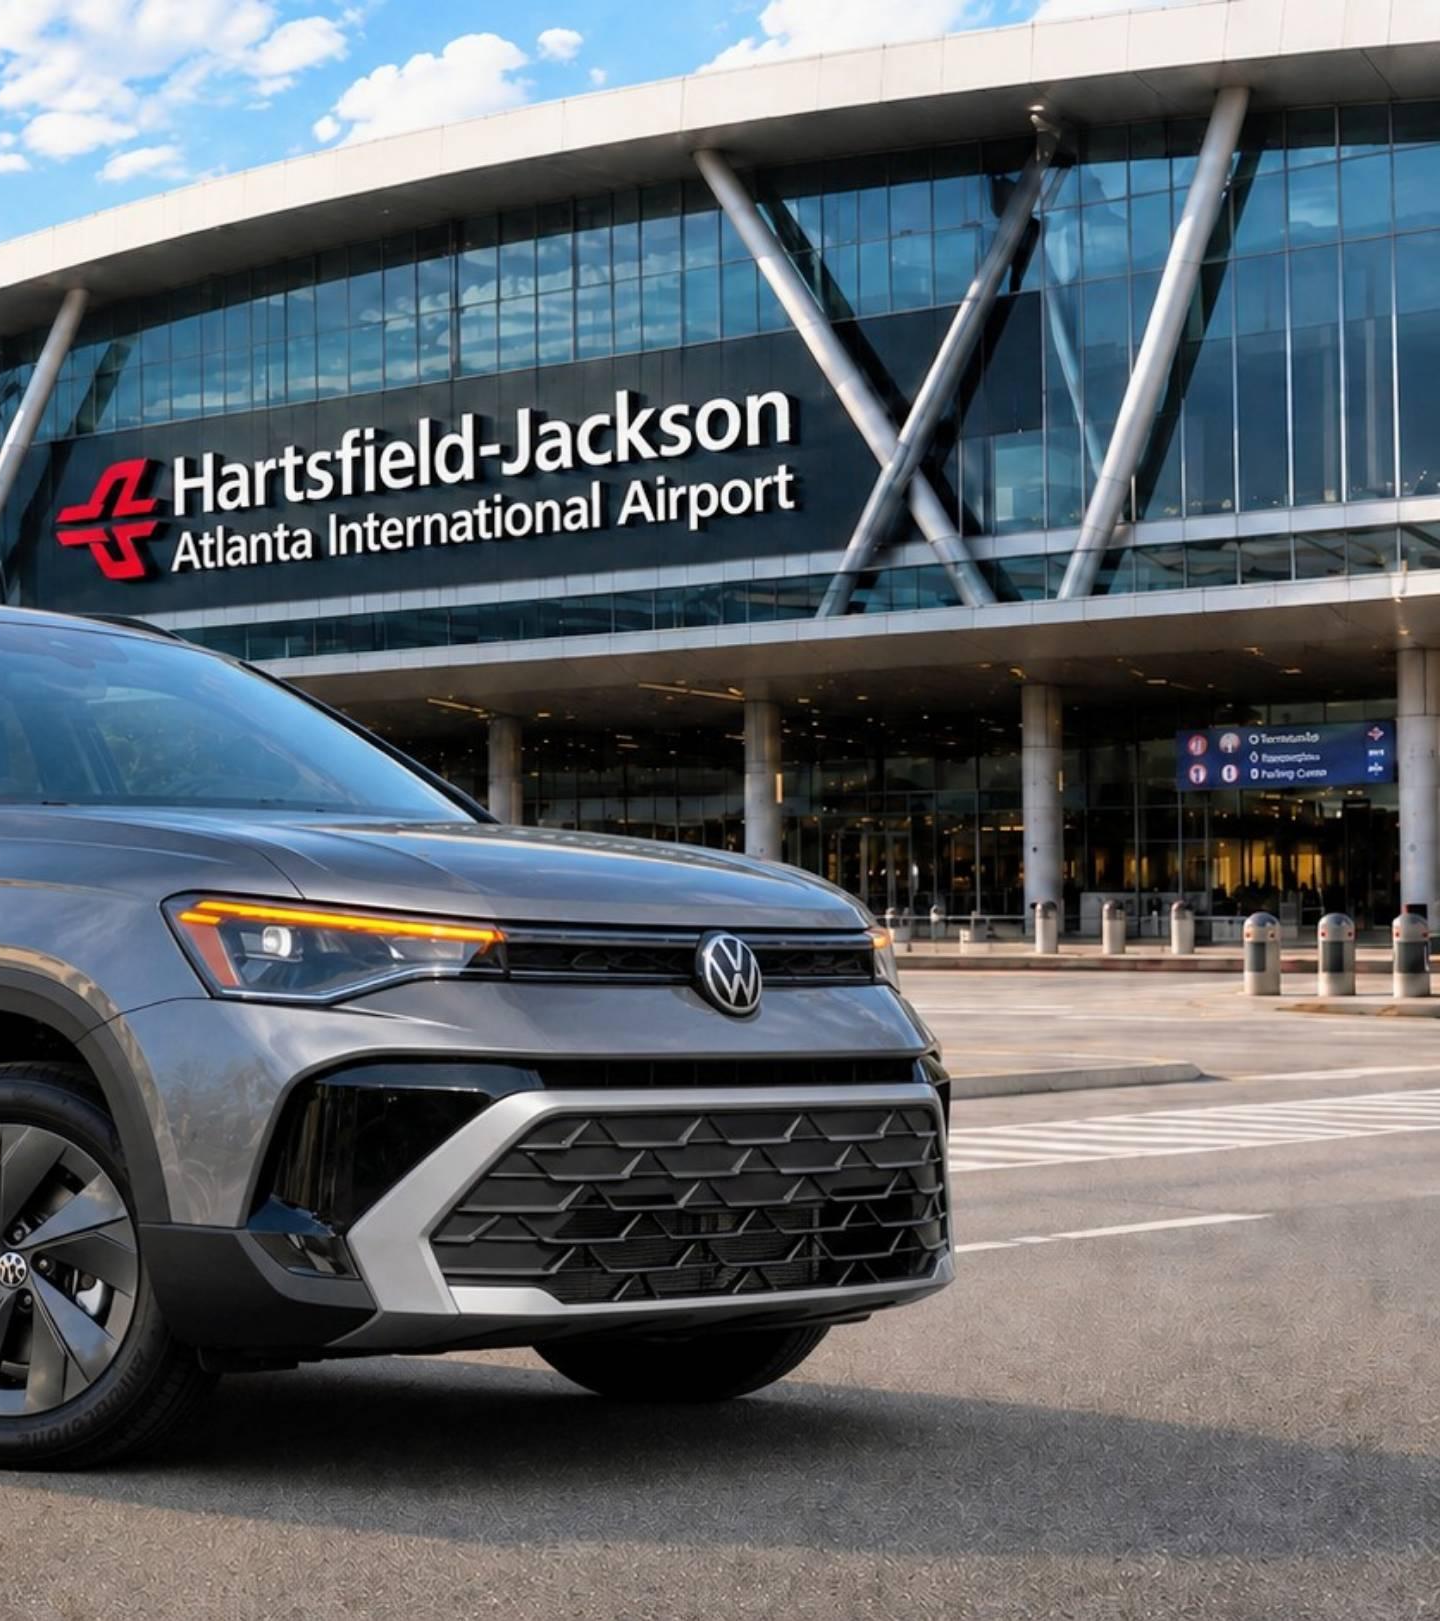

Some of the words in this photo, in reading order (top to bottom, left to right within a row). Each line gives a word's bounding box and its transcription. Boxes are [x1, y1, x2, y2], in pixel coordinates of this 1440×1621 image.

[173, 389, 791, 517] Hartsfield-Jackson
[171, 522, 314, 573] Atlanta
[328, 479, 602, 557] International
[617, 464, 796, 531] Airport
[702, 934, 762, 1014] VW
